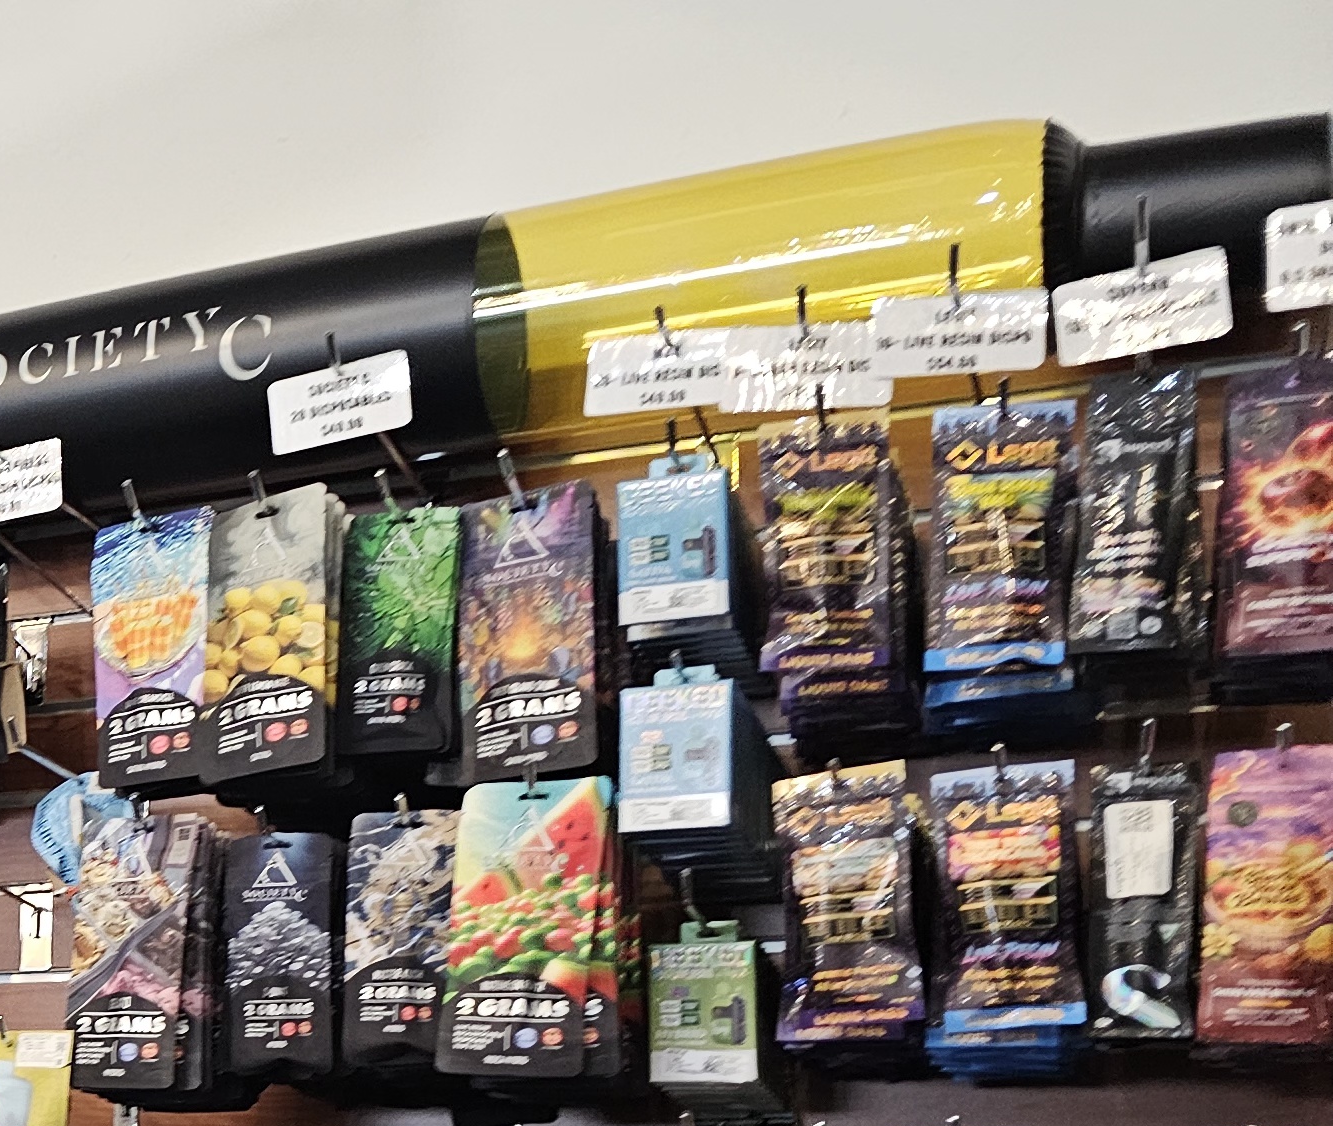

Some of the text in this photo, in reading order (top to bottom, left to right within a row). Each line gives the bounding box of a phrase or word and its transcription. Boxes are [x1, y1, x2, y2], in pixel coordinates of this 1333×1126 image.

[218, 313, 275, 382] C
[365, 676, 426, 695] GRAMS
[233, 691, 314, 724] GRAMS
[490, 691, 582, 724] GRAMS
[123, 706, 196, 732] GRAMS
[371, 983, 437, 1001] GRAMS
[255, 1000, 316, 1018] GRAMS
[473, 997, 570, 1018] GRAMS
[92, 1013, 168, 1035] GRAMS
